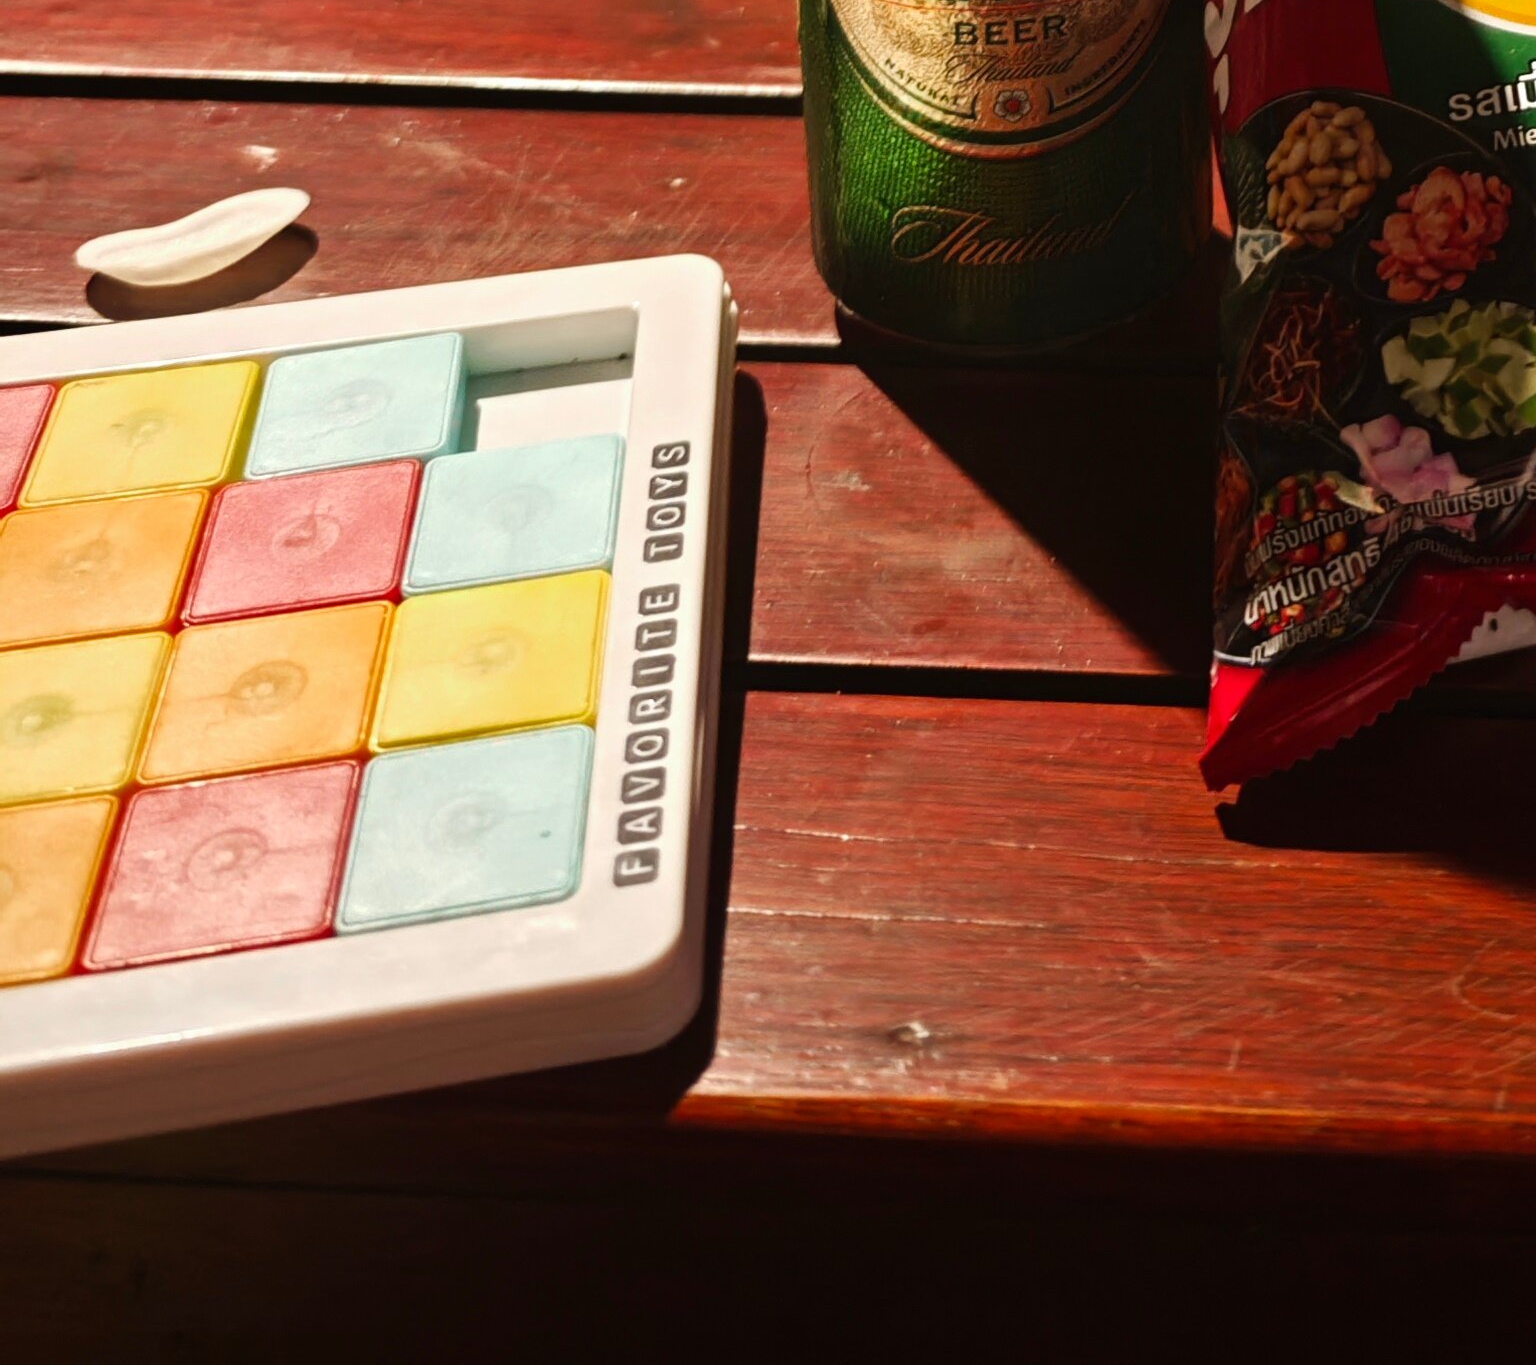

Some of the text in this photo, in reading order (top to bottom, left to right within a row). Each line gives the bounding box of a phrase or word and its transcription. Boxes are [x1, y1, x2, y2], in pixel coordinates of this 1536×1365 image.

[954, 14, 1067, 46] BEER
[892, 189, 1139, 265] Thailand
[644, 441, 690, 563] TOYS
[615, 584, 680, 885] FAVORITE
